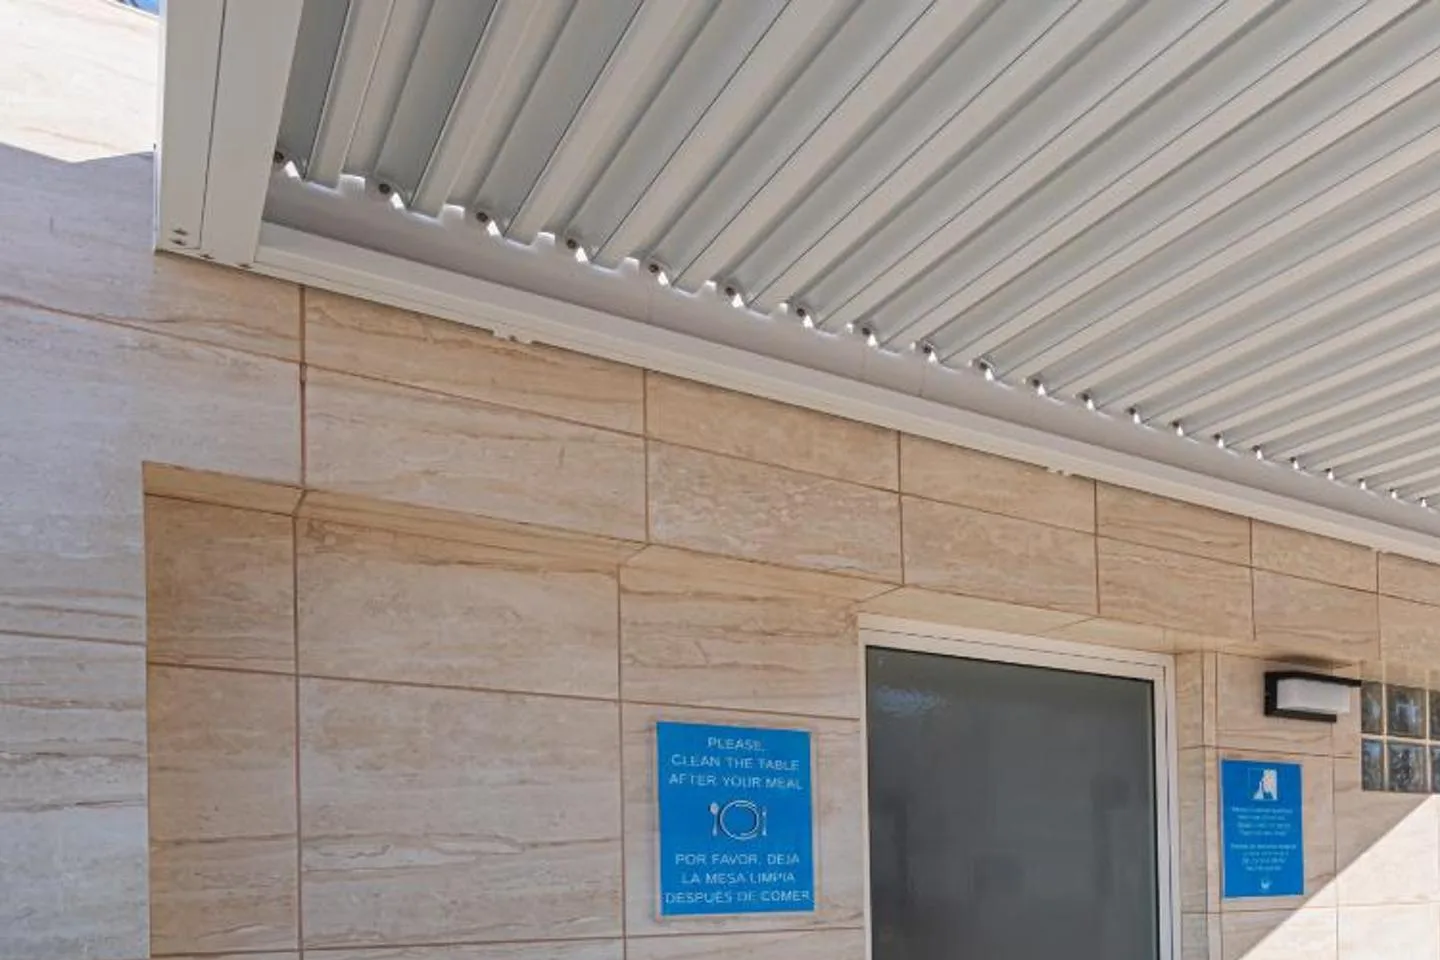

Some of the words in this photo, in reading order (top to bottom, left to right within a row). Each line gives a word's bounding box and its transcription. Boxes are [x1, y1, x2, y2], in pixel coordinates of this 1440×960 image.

[671, 753, 720, 767] CLEAN
[725, 756, 754, 769] THE
[758, 757, 800, 771] TABLE
[668, 772, 717, 786] AFTER
[722, 774, 761, 789] YOUR
[675, 853, 705, 865] POR
[681, 871, 701, 884] LA
[705, 872, 747, 884] MESA
[737, 890, 755, 902] DE
